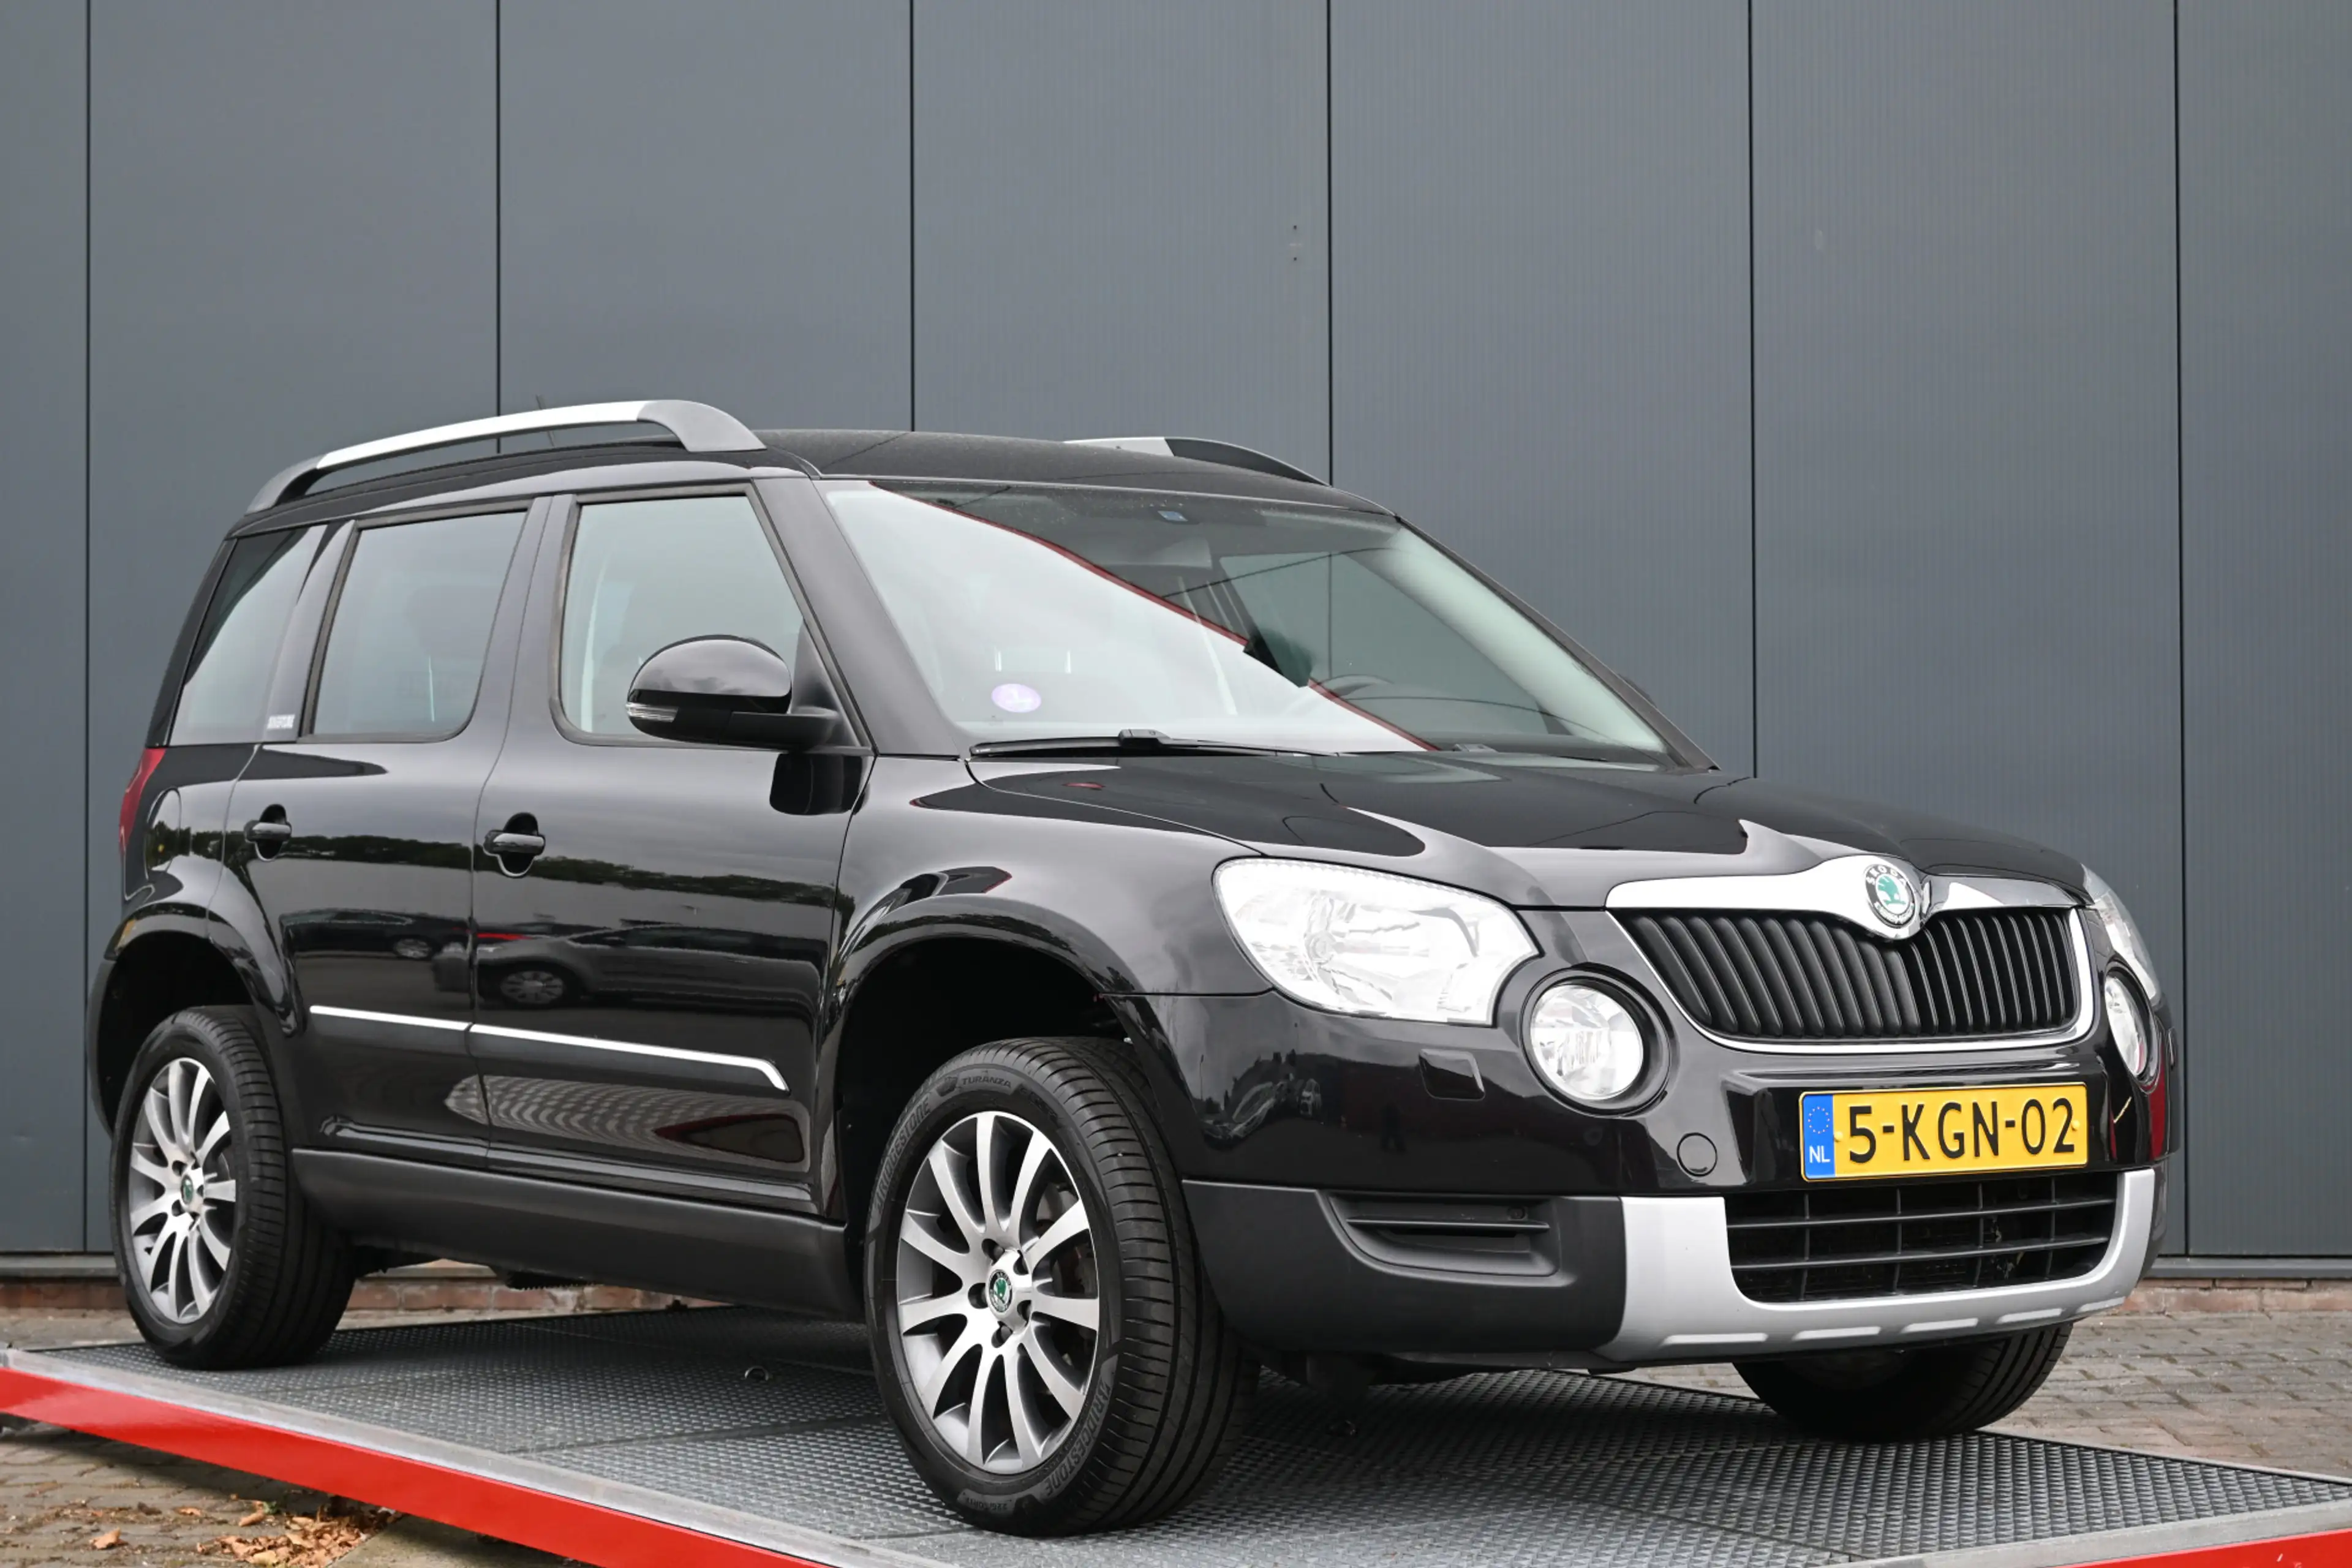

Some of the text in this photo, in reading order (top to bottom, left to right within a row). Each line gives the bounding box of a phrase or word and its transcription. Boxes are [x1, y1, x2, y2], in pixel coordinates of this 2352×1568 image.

[962, 1075, 1011, 1088] TURANZA
[1849, 1098, 2075, 1164] 5-KGN-02
[1809, 1145, 1831, 1164] NL
[1044, 1378, 1111, 1497] BRIDGESTONE
